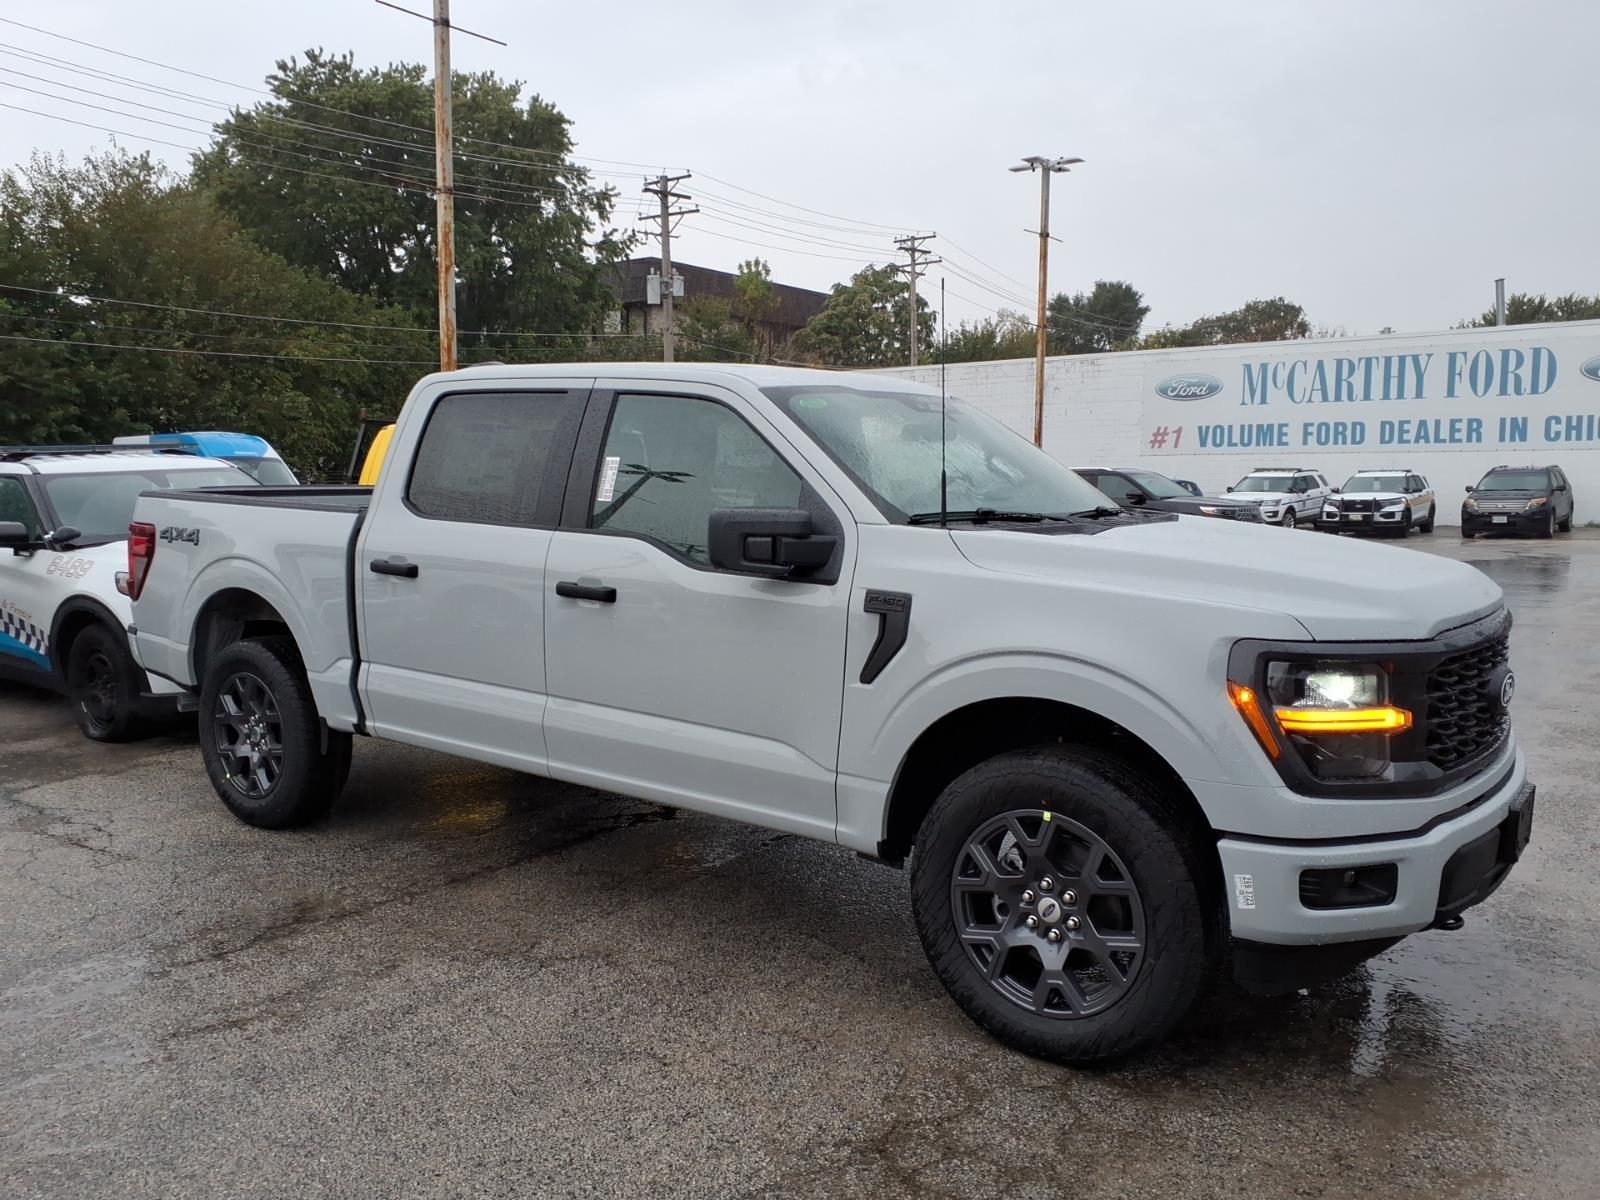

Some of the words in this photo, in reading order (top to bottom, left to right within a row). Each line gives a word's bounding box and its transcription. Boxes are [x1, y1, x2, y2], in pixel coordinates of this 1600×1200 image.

[1165, 376, 1212, 398] Ford
[1444, 346, 1558, 399] FORD
[1149, 426, 1183, 449] #1
[1198, 423, 1290, 448] VOLUME
[1302, 421, 1366, 446] FORD
[1379, 418, 1483, 445] DEALER
[1498, 416, 1528, 443] IN
[1544, 414, 1600, 442] CHI
